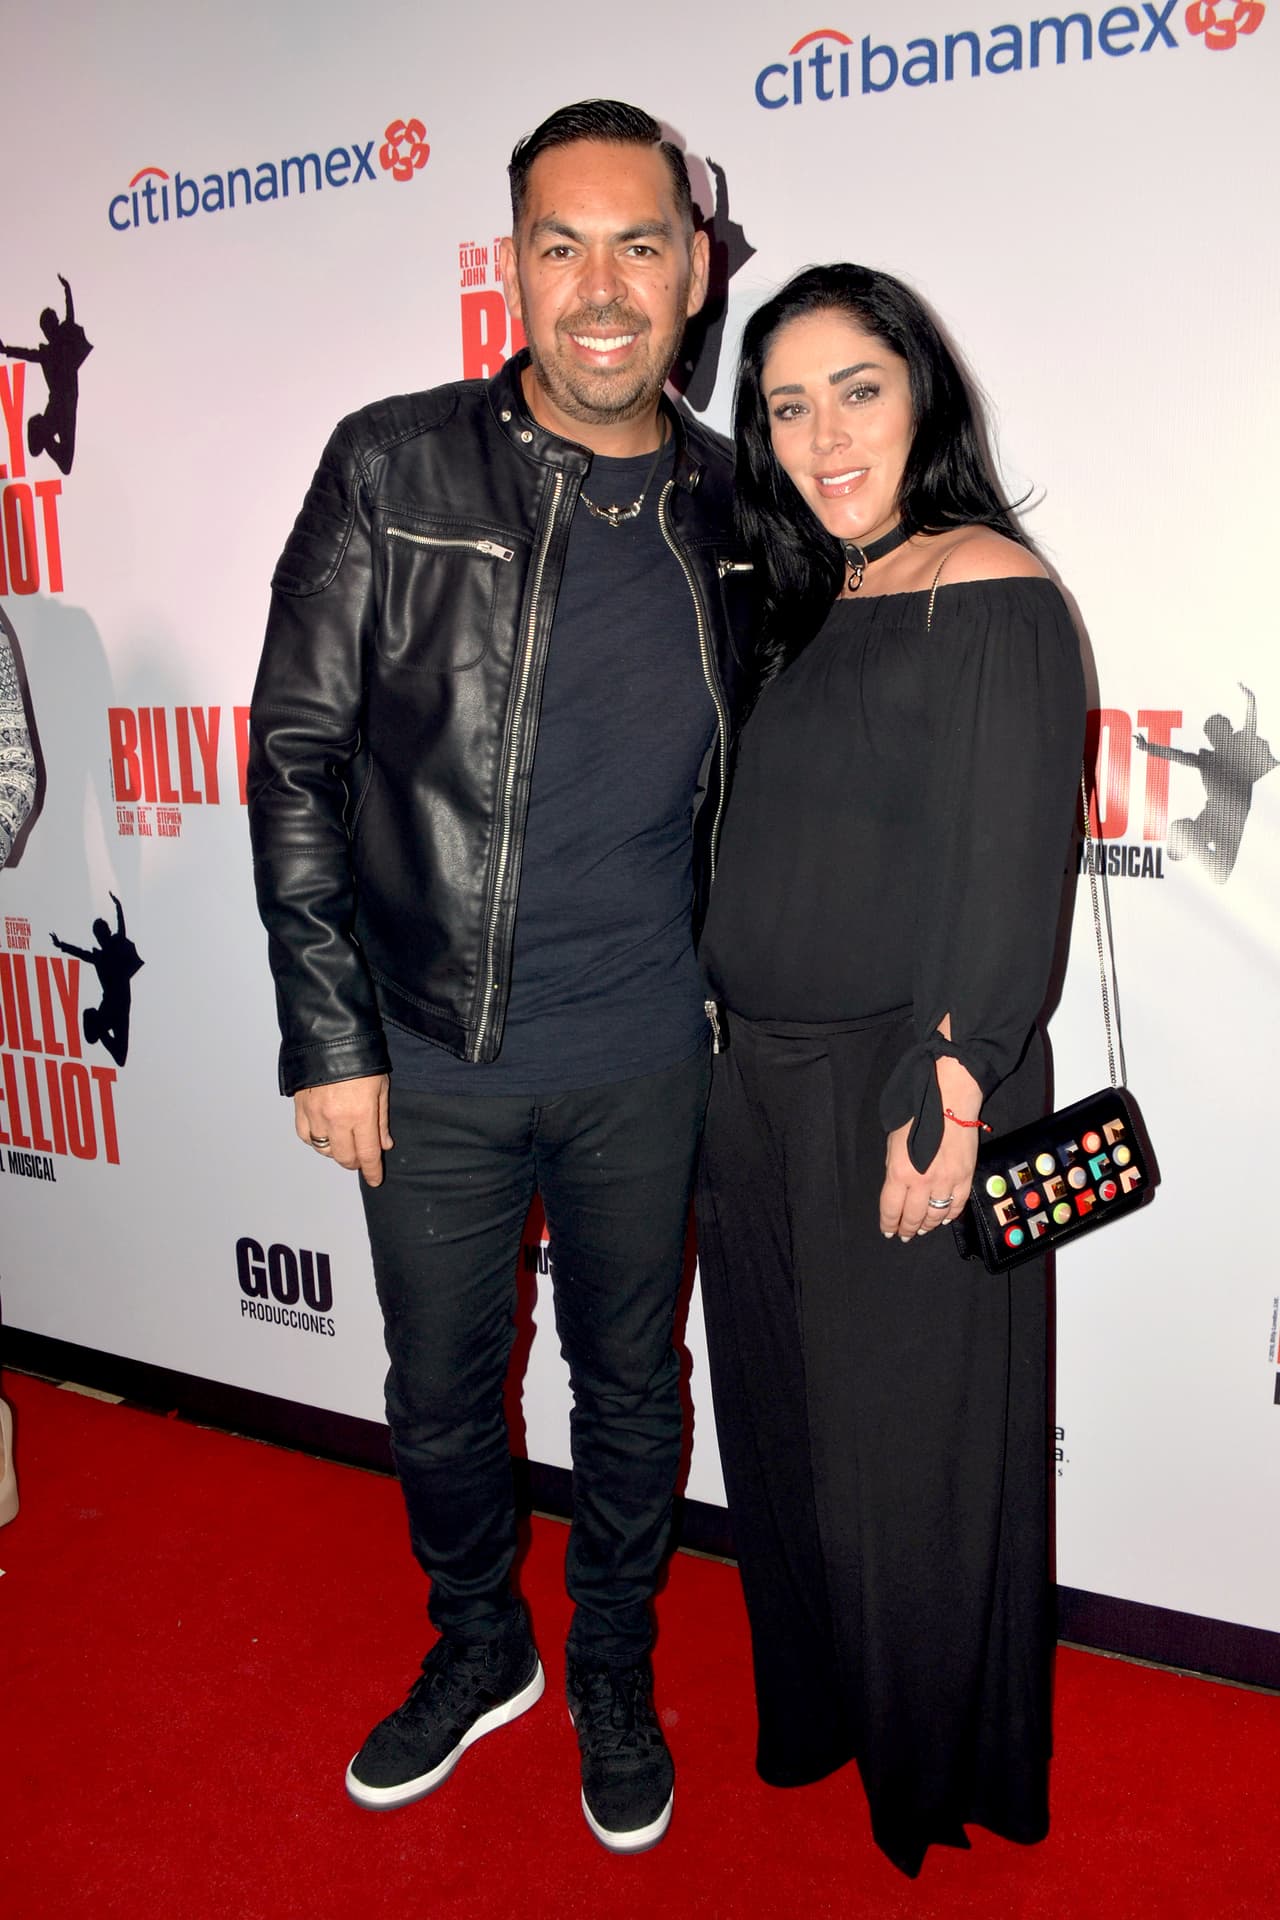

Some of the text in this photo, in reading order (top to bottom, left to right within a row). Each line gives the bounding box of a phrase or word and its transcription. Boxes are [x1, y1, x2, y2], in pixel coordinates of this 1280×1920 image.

[755, 0, 1179, 109] citibanamex
[108, 141, 377, 231] citibanamex
[459, 247, 488, 268] ELTON
[461, 267, 486, 287] JOHN
[108, 706, 221, 805] BILLY
[1078, 842, 1165, 879] MUSICAL
[0, 952, 82, 1059] ILLY
[7, 1150, 57, 1182] MUSICAL
[236, 1237, 333, 1313] GOU
[241, 1298, 335, 1337] PRODUCCIONES
